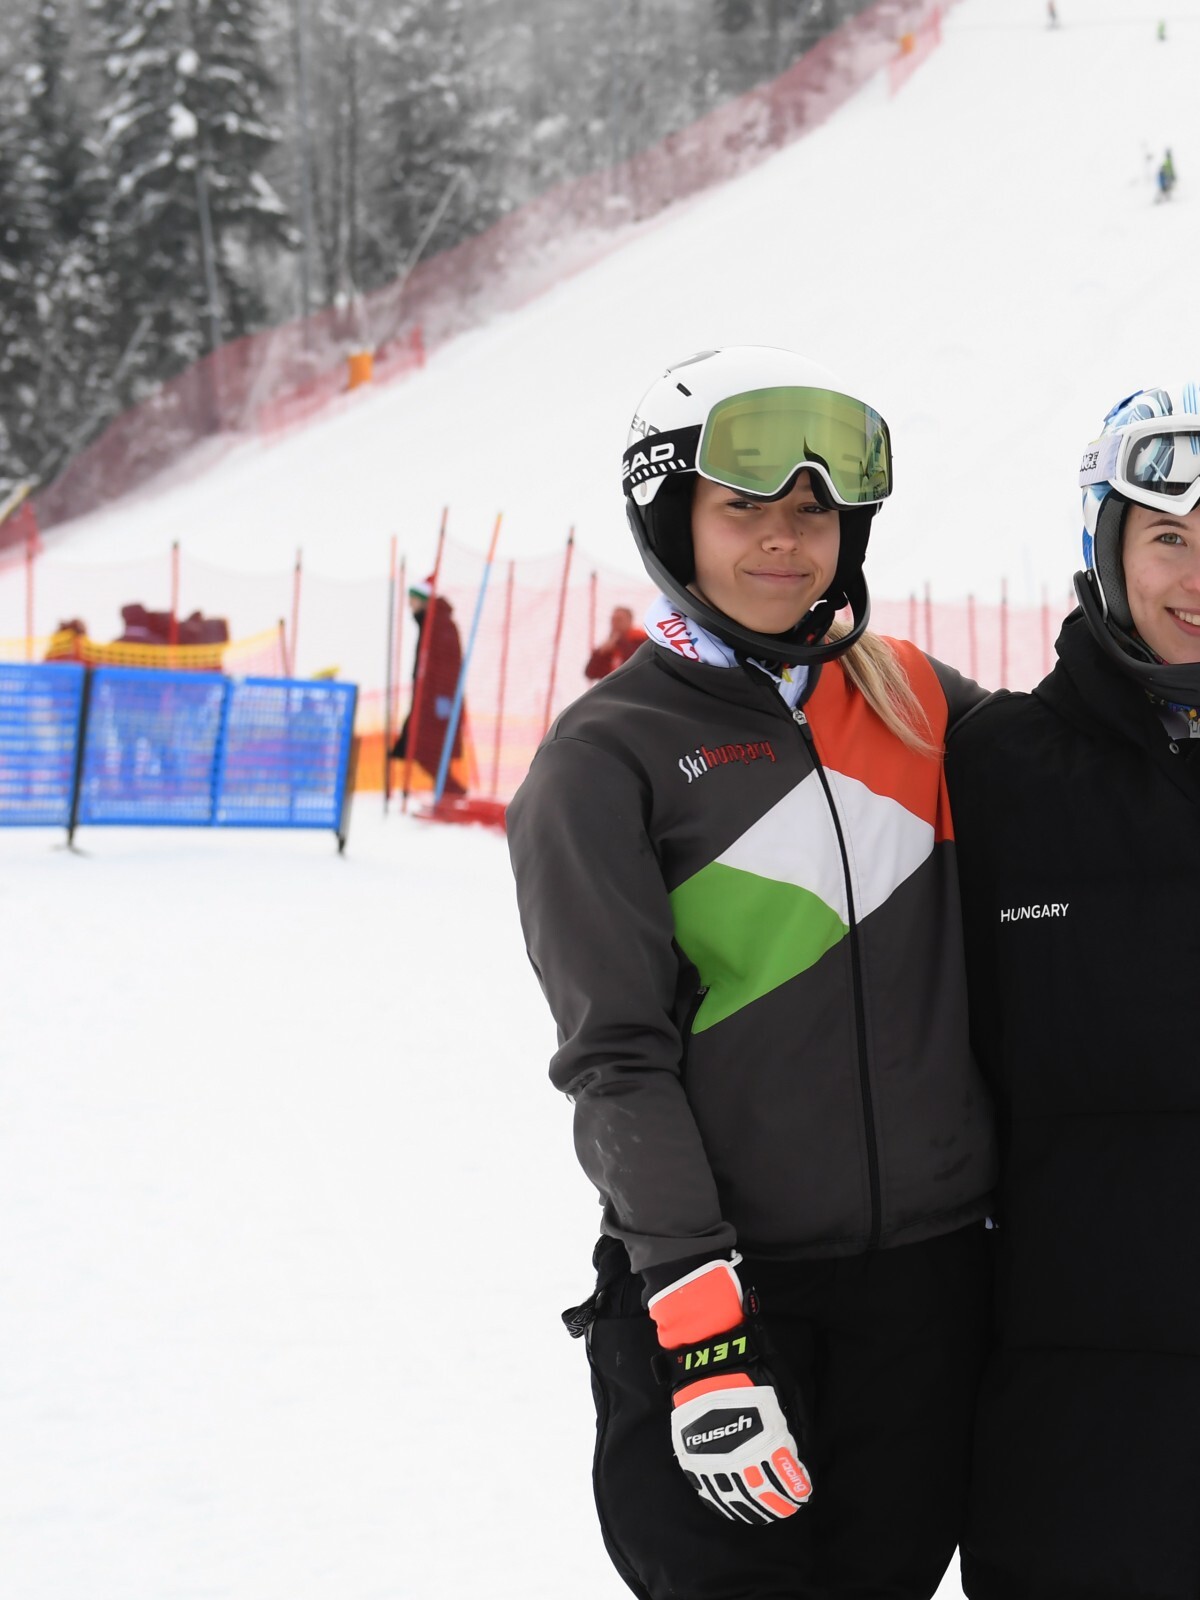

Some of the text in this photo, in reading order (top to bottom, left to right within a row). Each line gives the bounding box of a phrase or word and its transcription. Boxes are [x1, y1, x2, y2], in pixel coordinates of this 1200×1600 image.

[1000, 903, 1069, 923] HUNGARY
[685, 1336, 747, 1371] LEKI
[686, 1415, 753, 1447] reusch
[778, 1456, 807, 1493] racing
